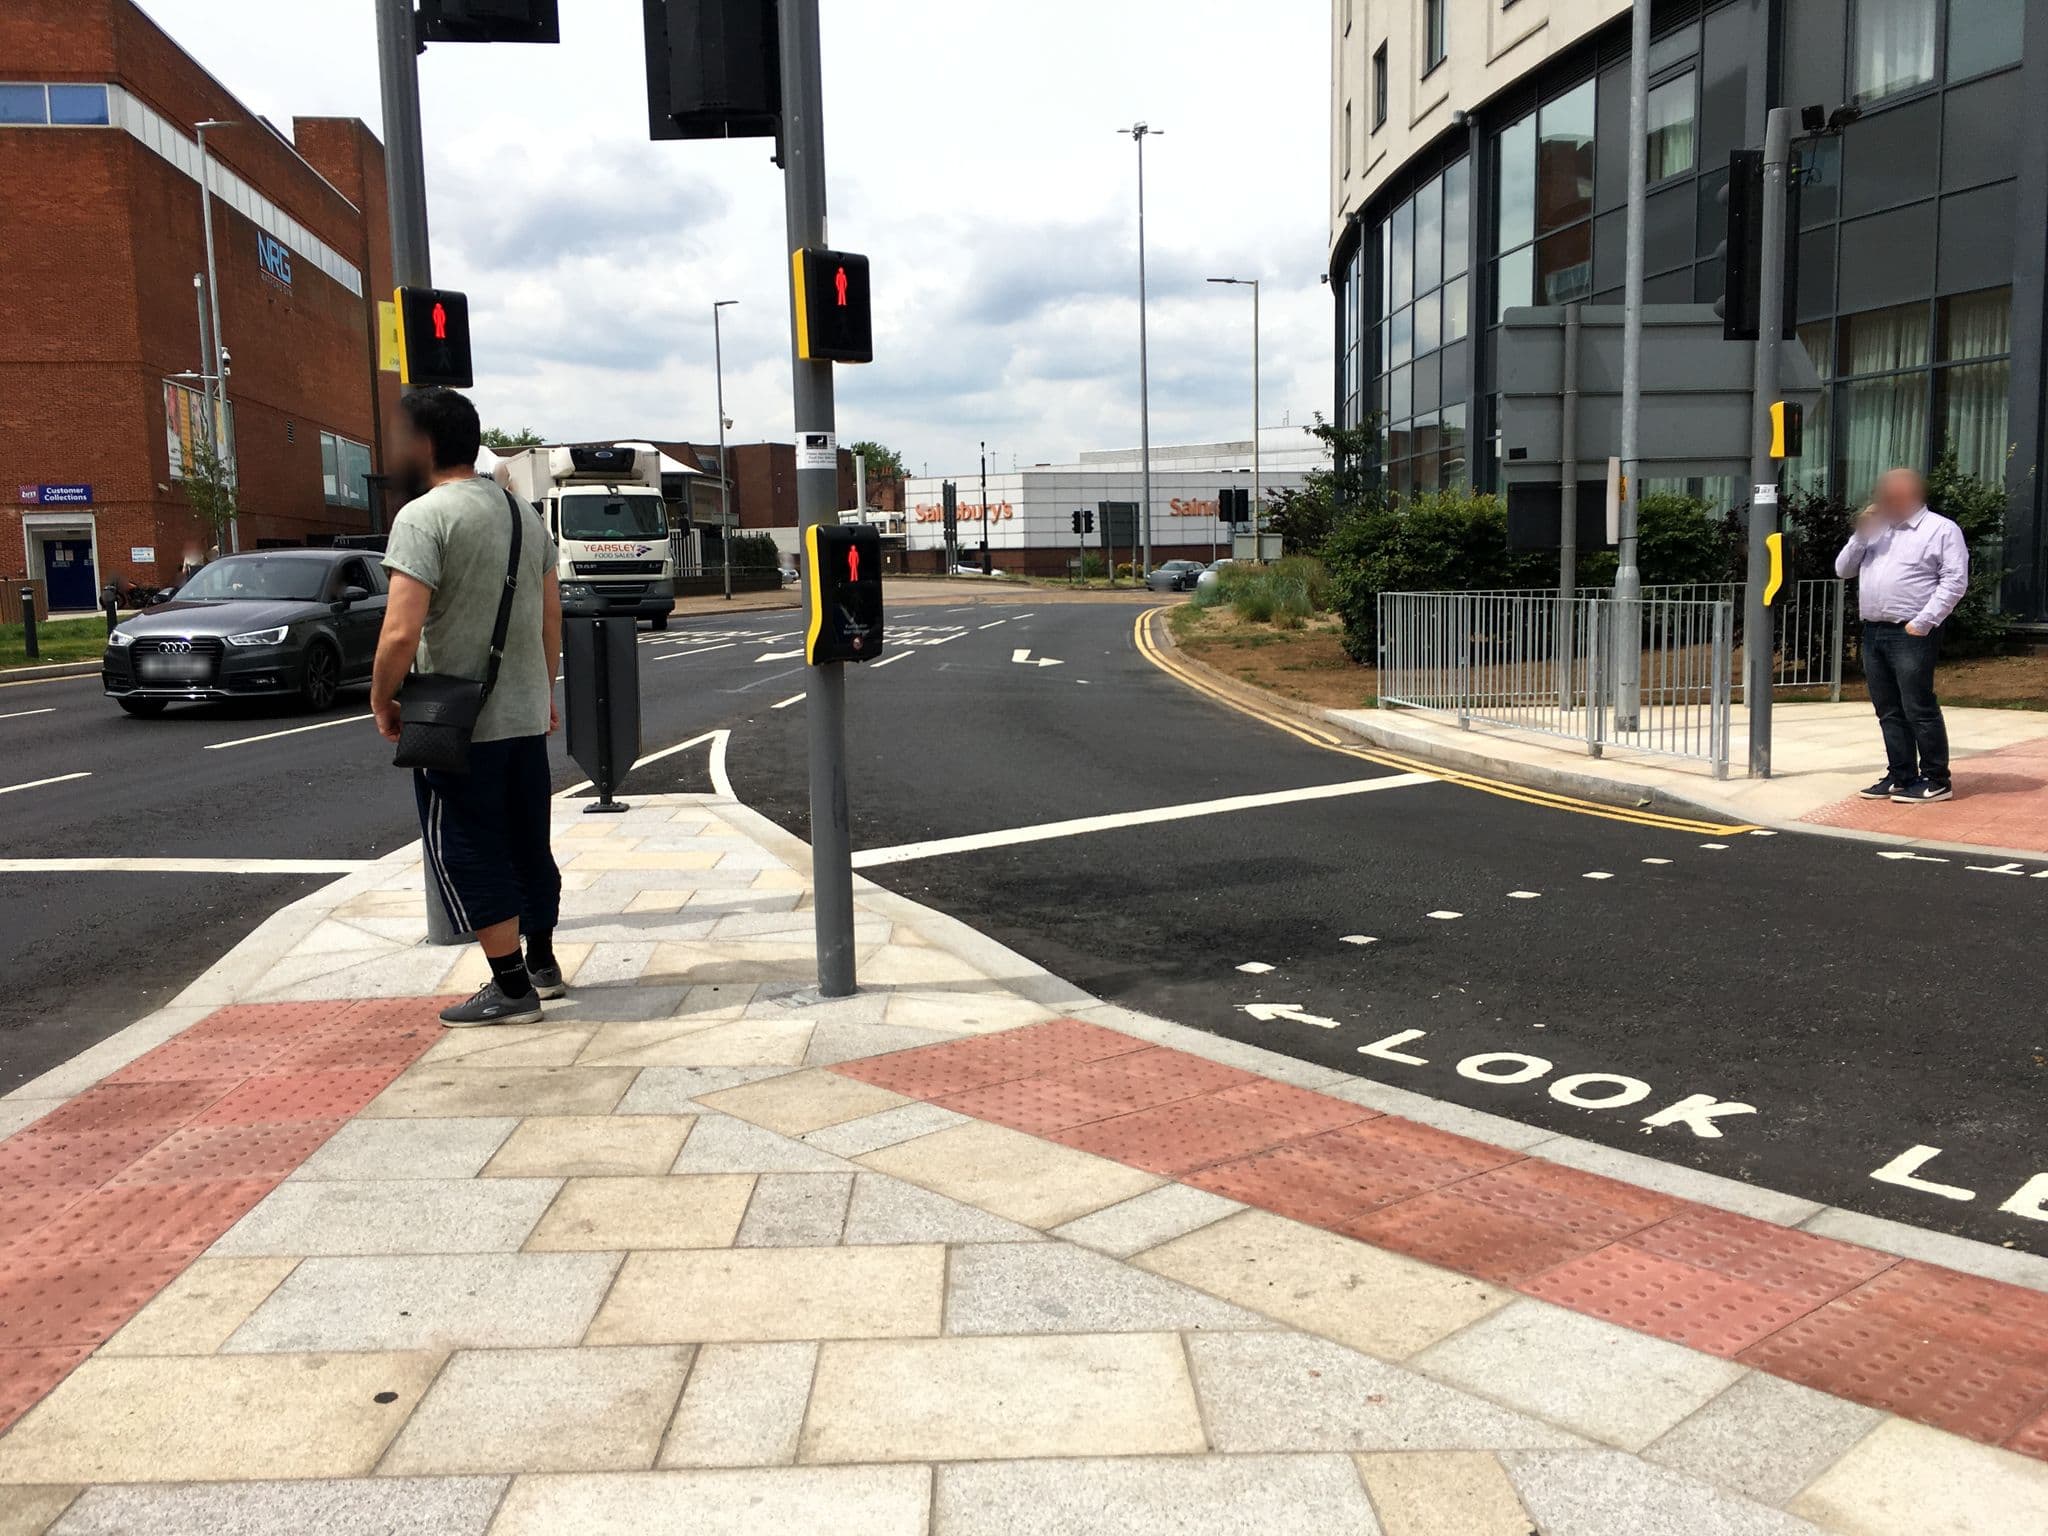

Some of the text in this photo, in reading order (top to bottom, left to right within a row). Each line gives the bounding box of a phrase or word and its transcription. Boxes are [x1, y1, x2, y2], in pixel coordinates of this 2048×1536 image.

[256, 230, 292, 284] NRG
[584, 544, 636, 552] YEARSLEY
[1357, 1028, 1757, 1138] LOOK
